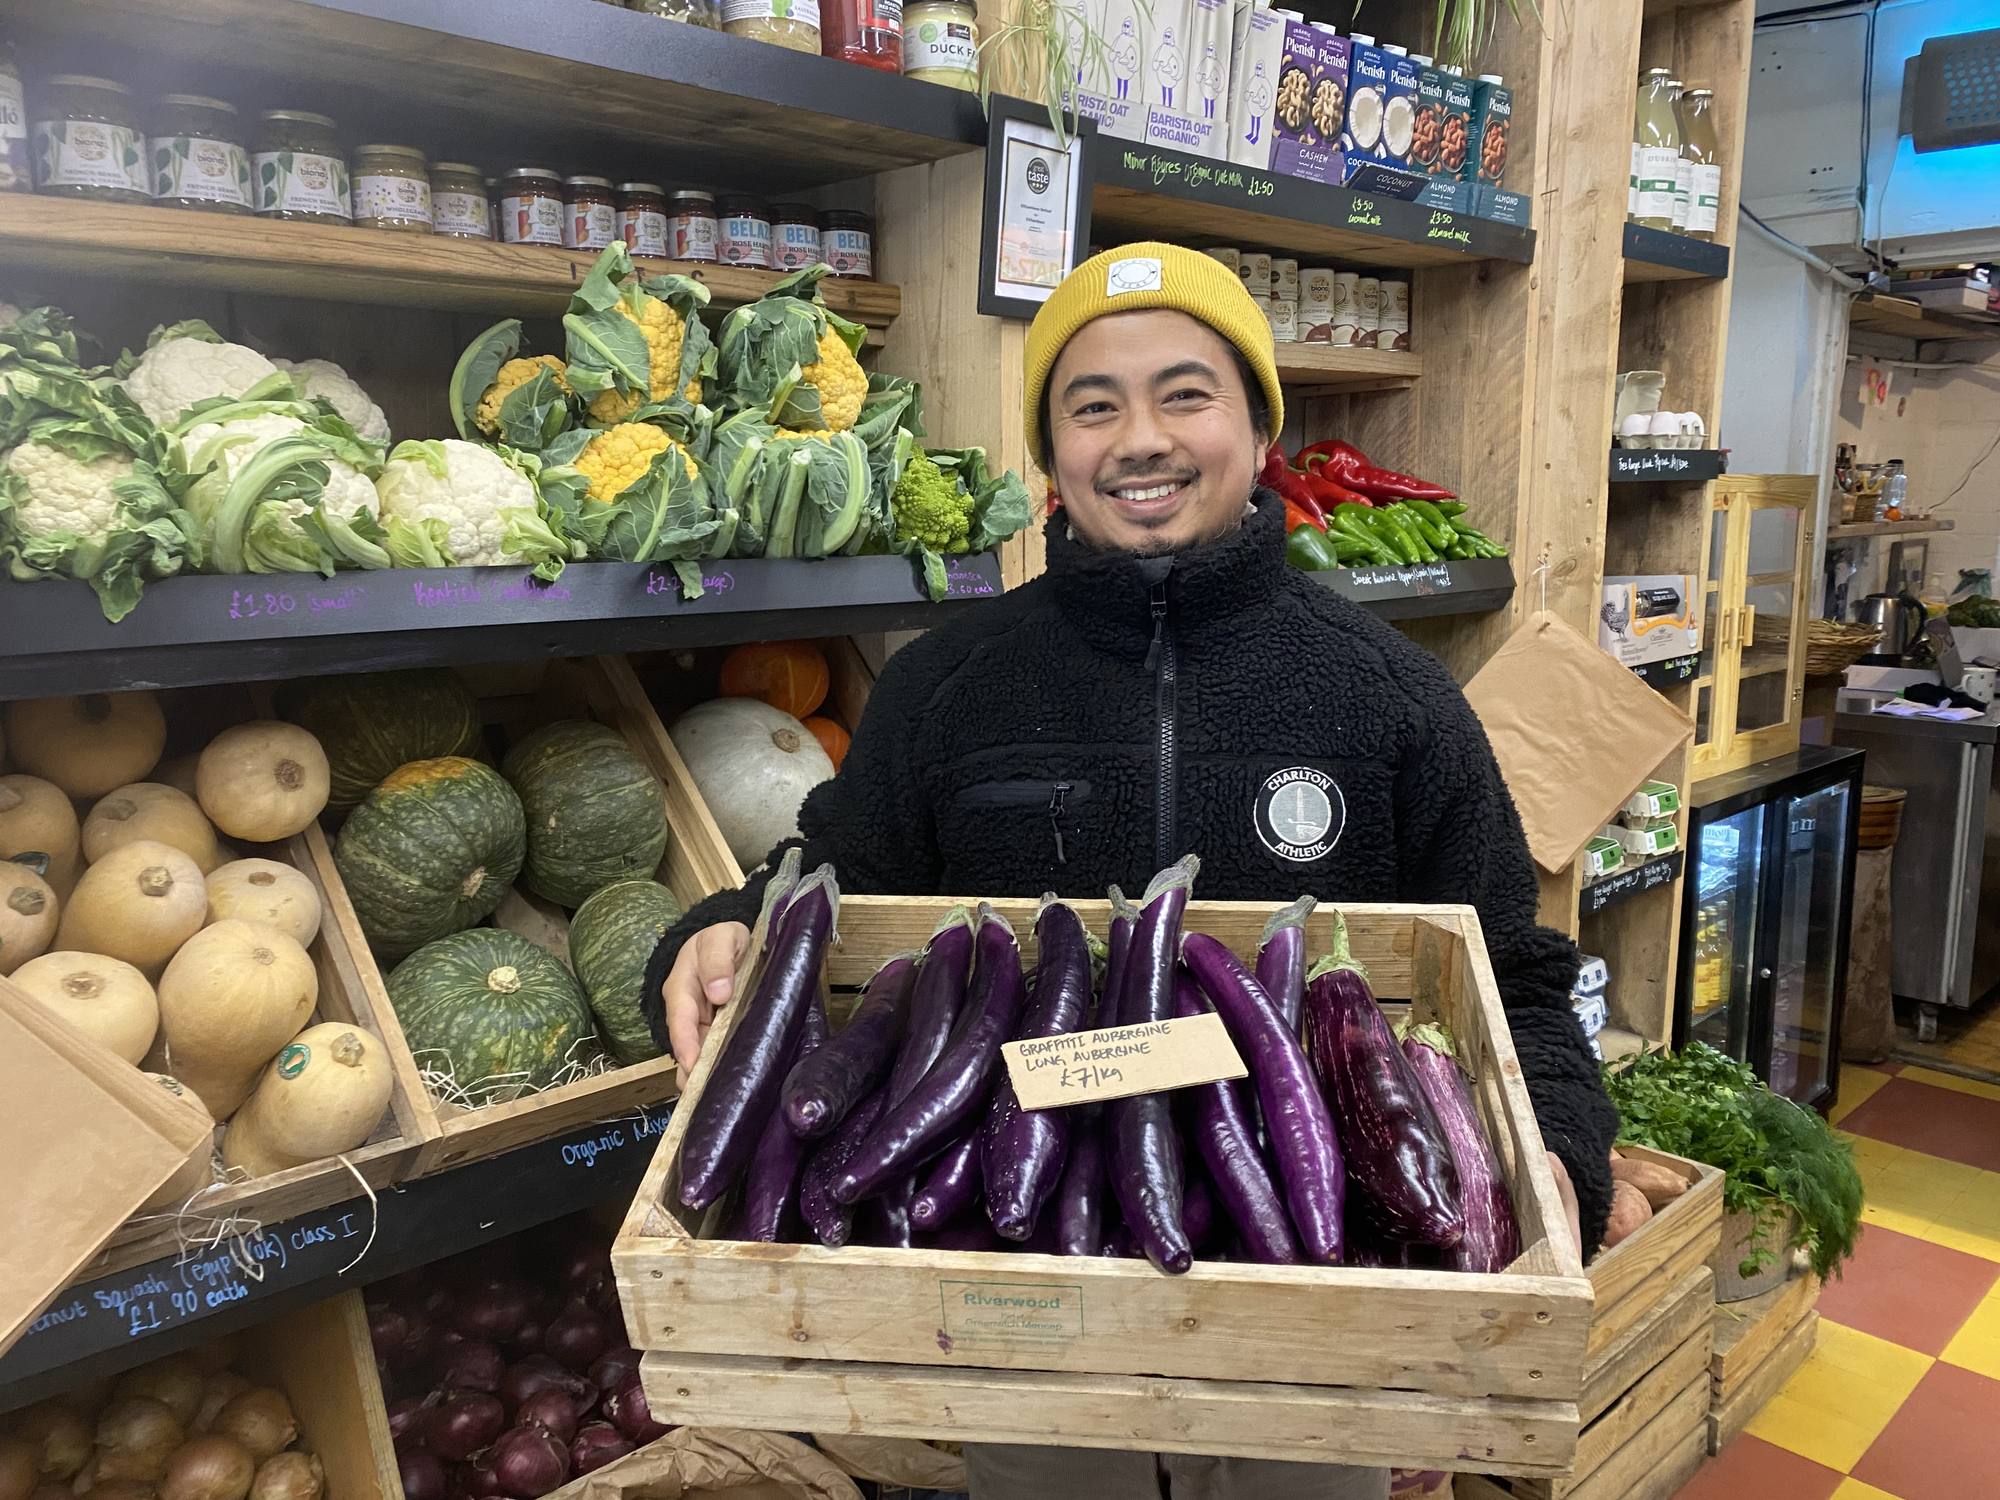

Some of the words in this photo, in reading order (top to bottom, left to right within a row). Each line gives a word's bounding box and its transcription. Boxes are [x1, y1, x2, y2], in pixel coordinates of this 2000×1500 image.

[930, 44, 964, 56] DUCK
[1285, 37, 1316, 59] Plenish
[1319, 48, 1348, 70] Plenish
[1356, 59, 1386, 80] Plenish
[1390, 69, 1418, 90] Plenish
[1062, 91, 1107, 111] BRISTA
[1109, 102, 1130, 118] OAT
[1445, 89, 1471, 108] Plenish
[1489, 97, 1511, 116] Plenish
[1150, 111, 1193, 134] BARISTA
[1194, 123, 1213, 137] OAT
[1149, 123, 1200, 147] (ORGANIC)
[1299, 148, 1329, 163] CASHEW
[1028, 170, 1049, 184] taste
[1376, 174, 1413, 188] COCONUT
[1430, 182, 1456, 194] ALMOND
[1494, 194, 1519, 206] ALMOND
[729, 220, 770, 240] BELAZ
[785, 227, 820, 245] BELA
[732, 240, 752, 248] ROSE
[837, 232, 870, 250] BELA
[647, 571, 682, 595] £2.2
[703, 571, 736, 595] arge)
[1267, 770, 1331, 791] CHARLTON
[1274, 841, 1327, 858] ATHLETIC
[1092, 1022, 1172, 1044] AUBERGINE
[1025, 1055, 1066, 1072] LONG
[1073, 1041, 1152, 1063] AUBERGINE
[562, 1129, 626, 1168] Organic
[94, 1274, 170, 1318] Squash
[291, 1223, 336, 1250] Class
[337, 1213, 359, 1238] I
[128, 1288, 199, 1337] £1.90
[205, 1283, 249, 1308] each
[963, 1293, 1060, 1309] Riverwood
